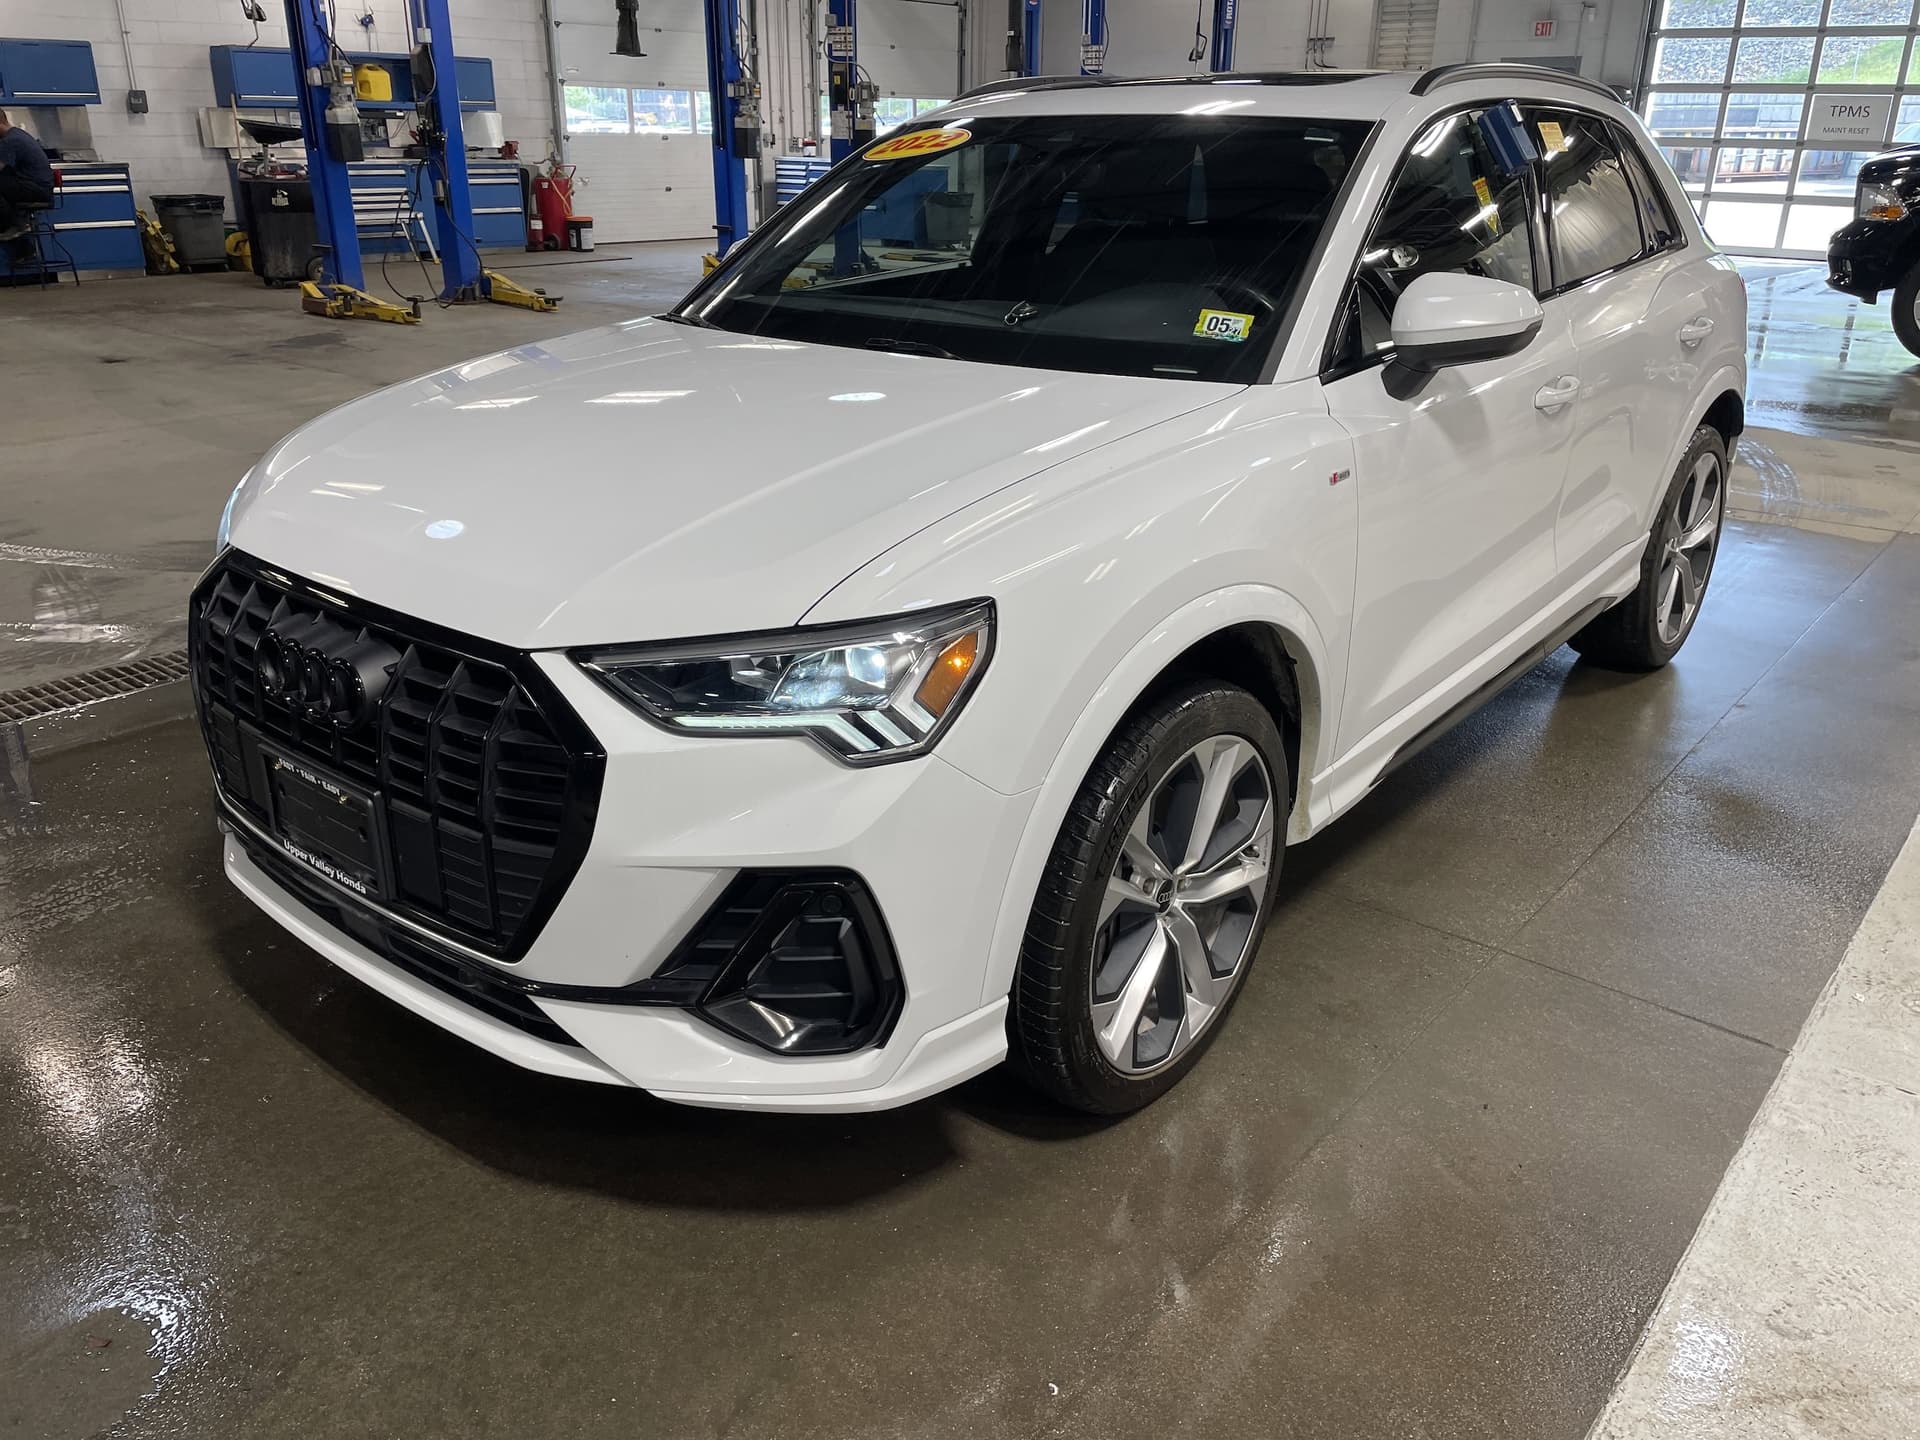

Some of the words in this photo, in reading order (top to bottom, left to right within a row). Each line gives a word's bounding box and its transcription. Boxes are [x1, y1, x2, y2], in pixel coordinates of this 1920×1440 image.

[1535, 21, 1553, 37] EXIT
[1830, 105, 1871, 118] TPMS
[1848, 127, 1870, 135] RESET
[870, 131, 965, 156] 2022
[1206, 316, 1232, 333] 05
[283, 839, 308, 861] Upper
[308, 854, 335, 878] Valley
[336, 870, 366, 895] Honda
